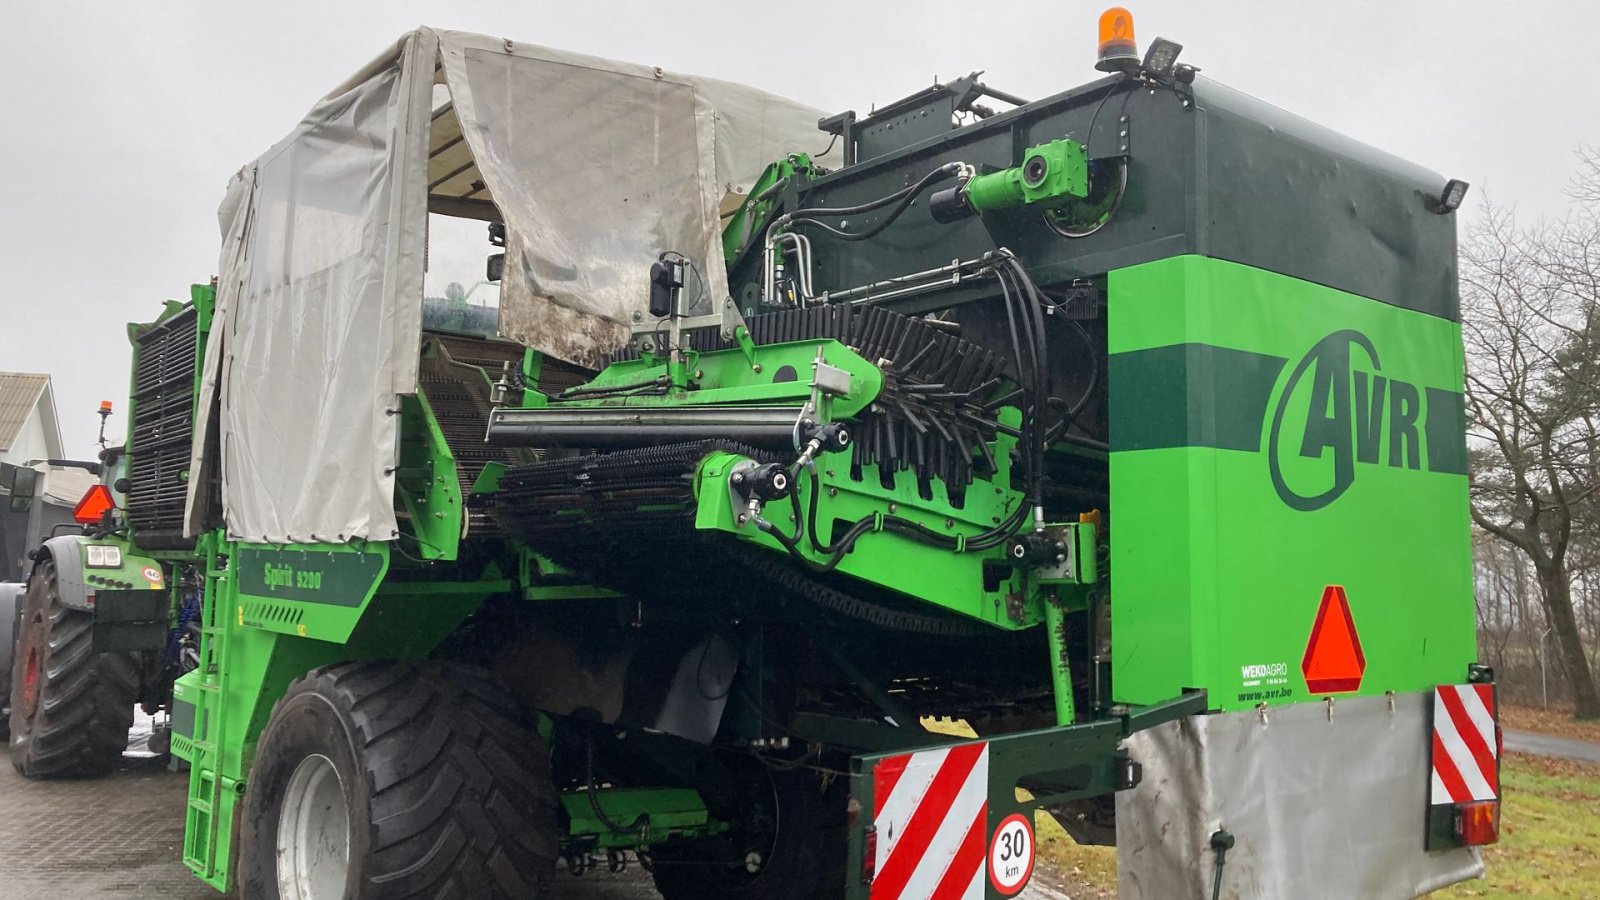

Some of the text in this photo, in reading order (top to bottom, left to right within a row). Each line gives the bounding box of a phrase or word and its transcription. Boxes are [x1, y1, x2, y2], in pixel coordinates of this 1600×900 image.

[1269, 329, 1420, 511] AVR
[264, 562, 293, 590] Spirit
[1238, 687, 1292, 702] www.avr.be
[1001, 829, 1024, 861] 30
[1005, 866, 1019, 879] km
